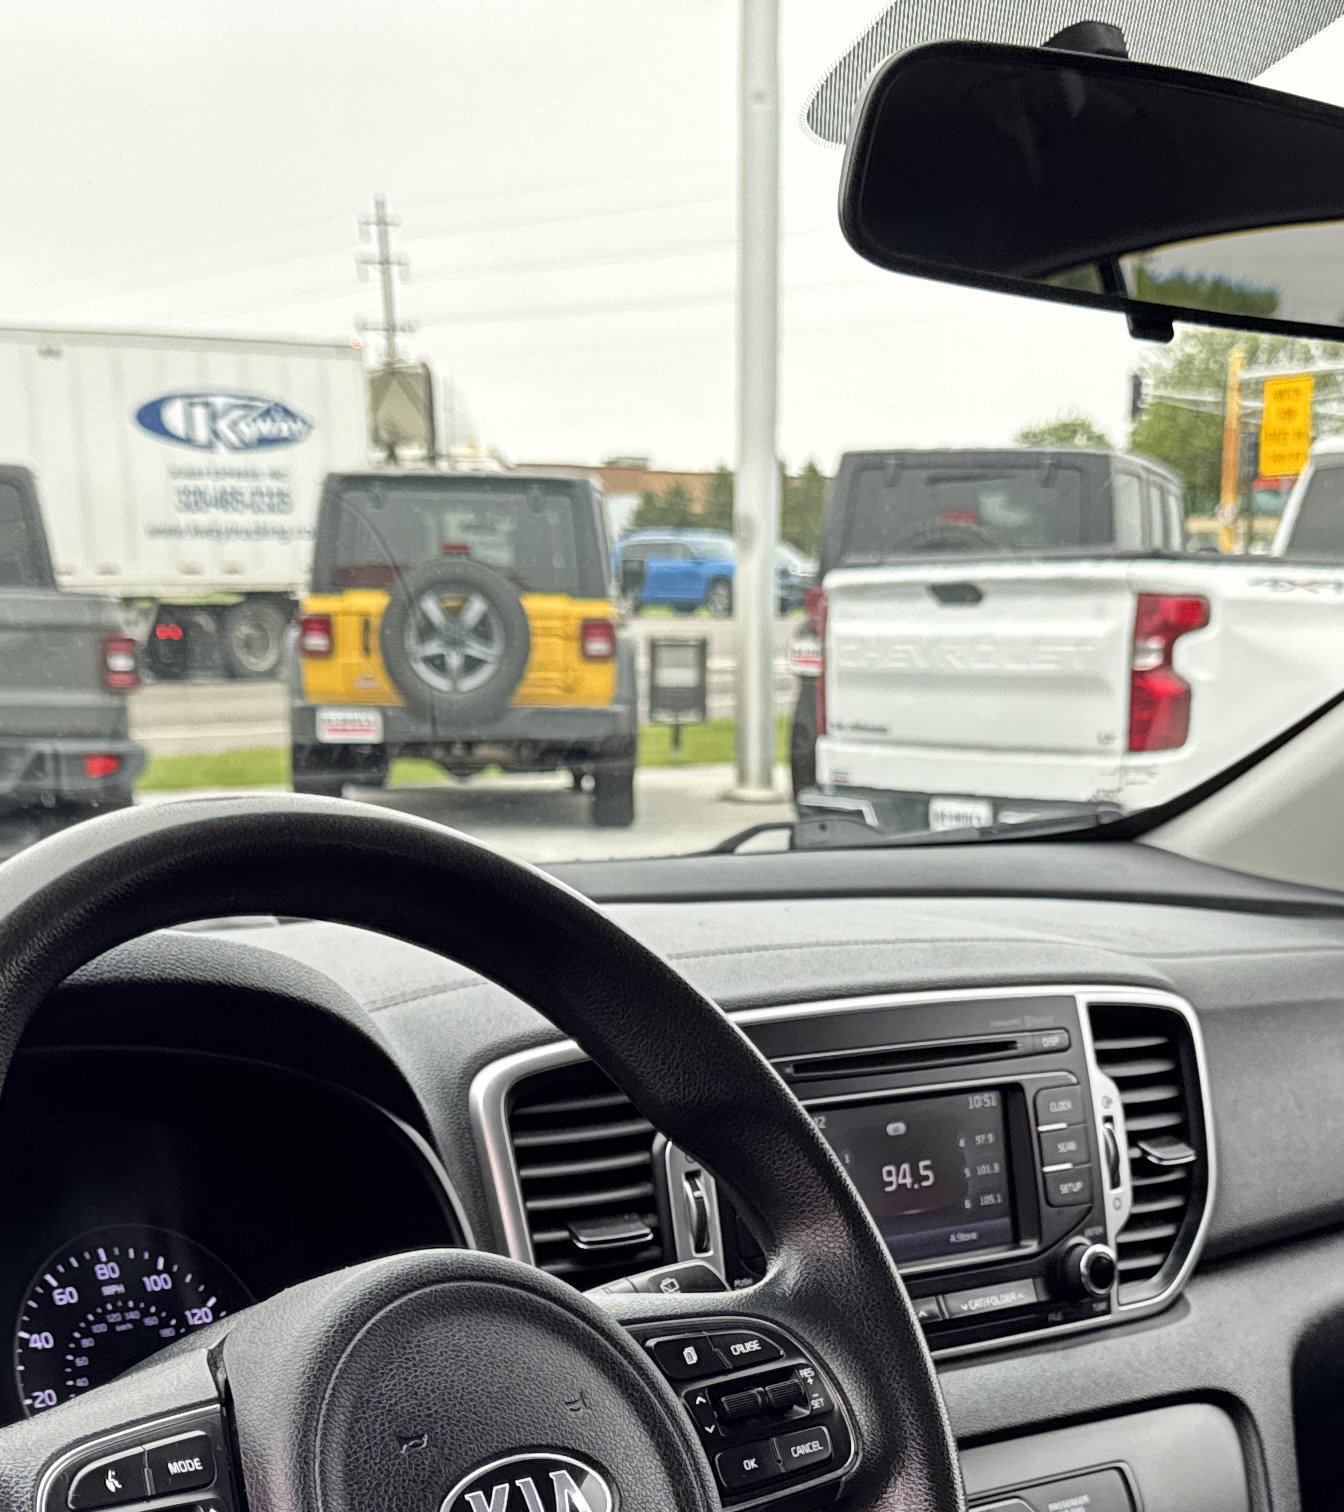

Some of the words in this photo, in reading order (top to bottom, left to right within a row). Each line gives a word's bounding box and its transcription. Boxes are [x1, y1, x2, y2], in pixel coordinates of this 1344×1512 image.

[882, 1160, 935, 1192] 94.5
[95, 1261, 120, 1279] 80
[143, 1274, 172, 1292] 100
[52, 1286, 78, 1305] 60
[185, 1308, 213, 1325] 120
[28, 1331, 54, 1350] 40
[32, 1389, 57, 1408] 20
[790, 1440, 824, 1458] CANCEL
[167, 1457, 204, 1475] MODE
[742, 1458, 758, 1471] OK
